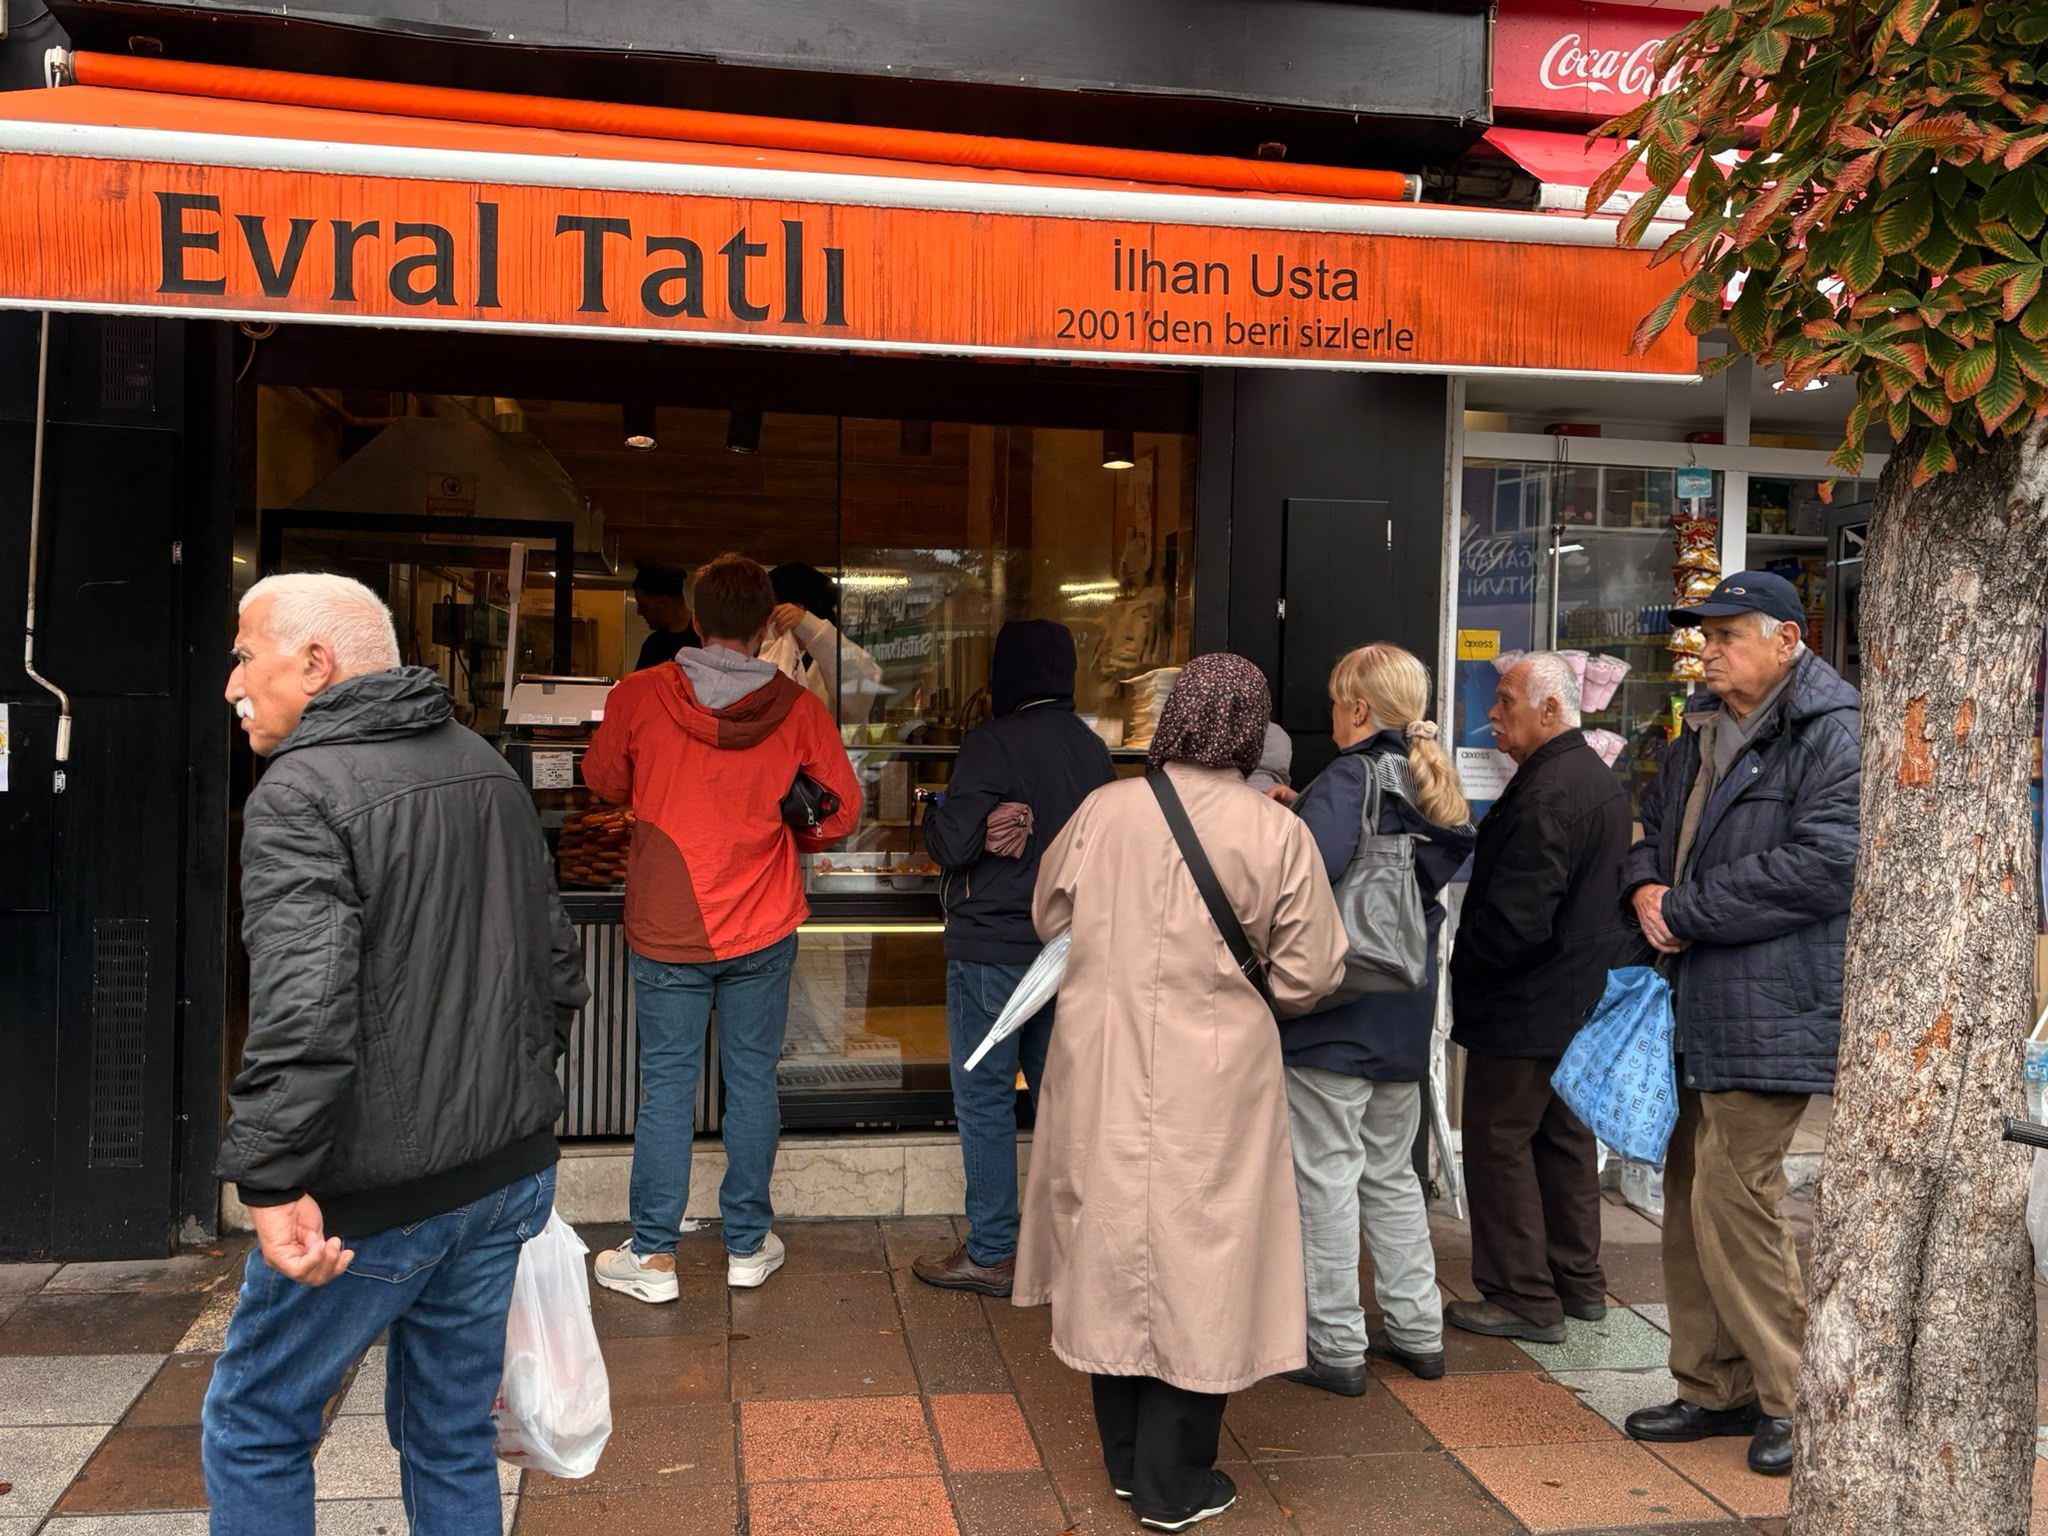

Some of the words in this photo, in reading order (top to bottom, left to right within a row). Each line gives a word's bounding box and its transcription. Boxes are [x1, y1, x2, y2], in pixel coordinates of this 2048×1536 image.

[154, 191, 503, 308] Evral
[555, 214, 849, 327] Tatlı
[1114, 238, 1230, 295] İlhan
[1251, 253, 1359, 301] Usta
[1056, 307, 1213, 344] 2001'den
[1225, 312, 1290, 346] beri
[1300, 317, 1414, 352] sizlerle
[1464, 640, 1494, 649] axess
